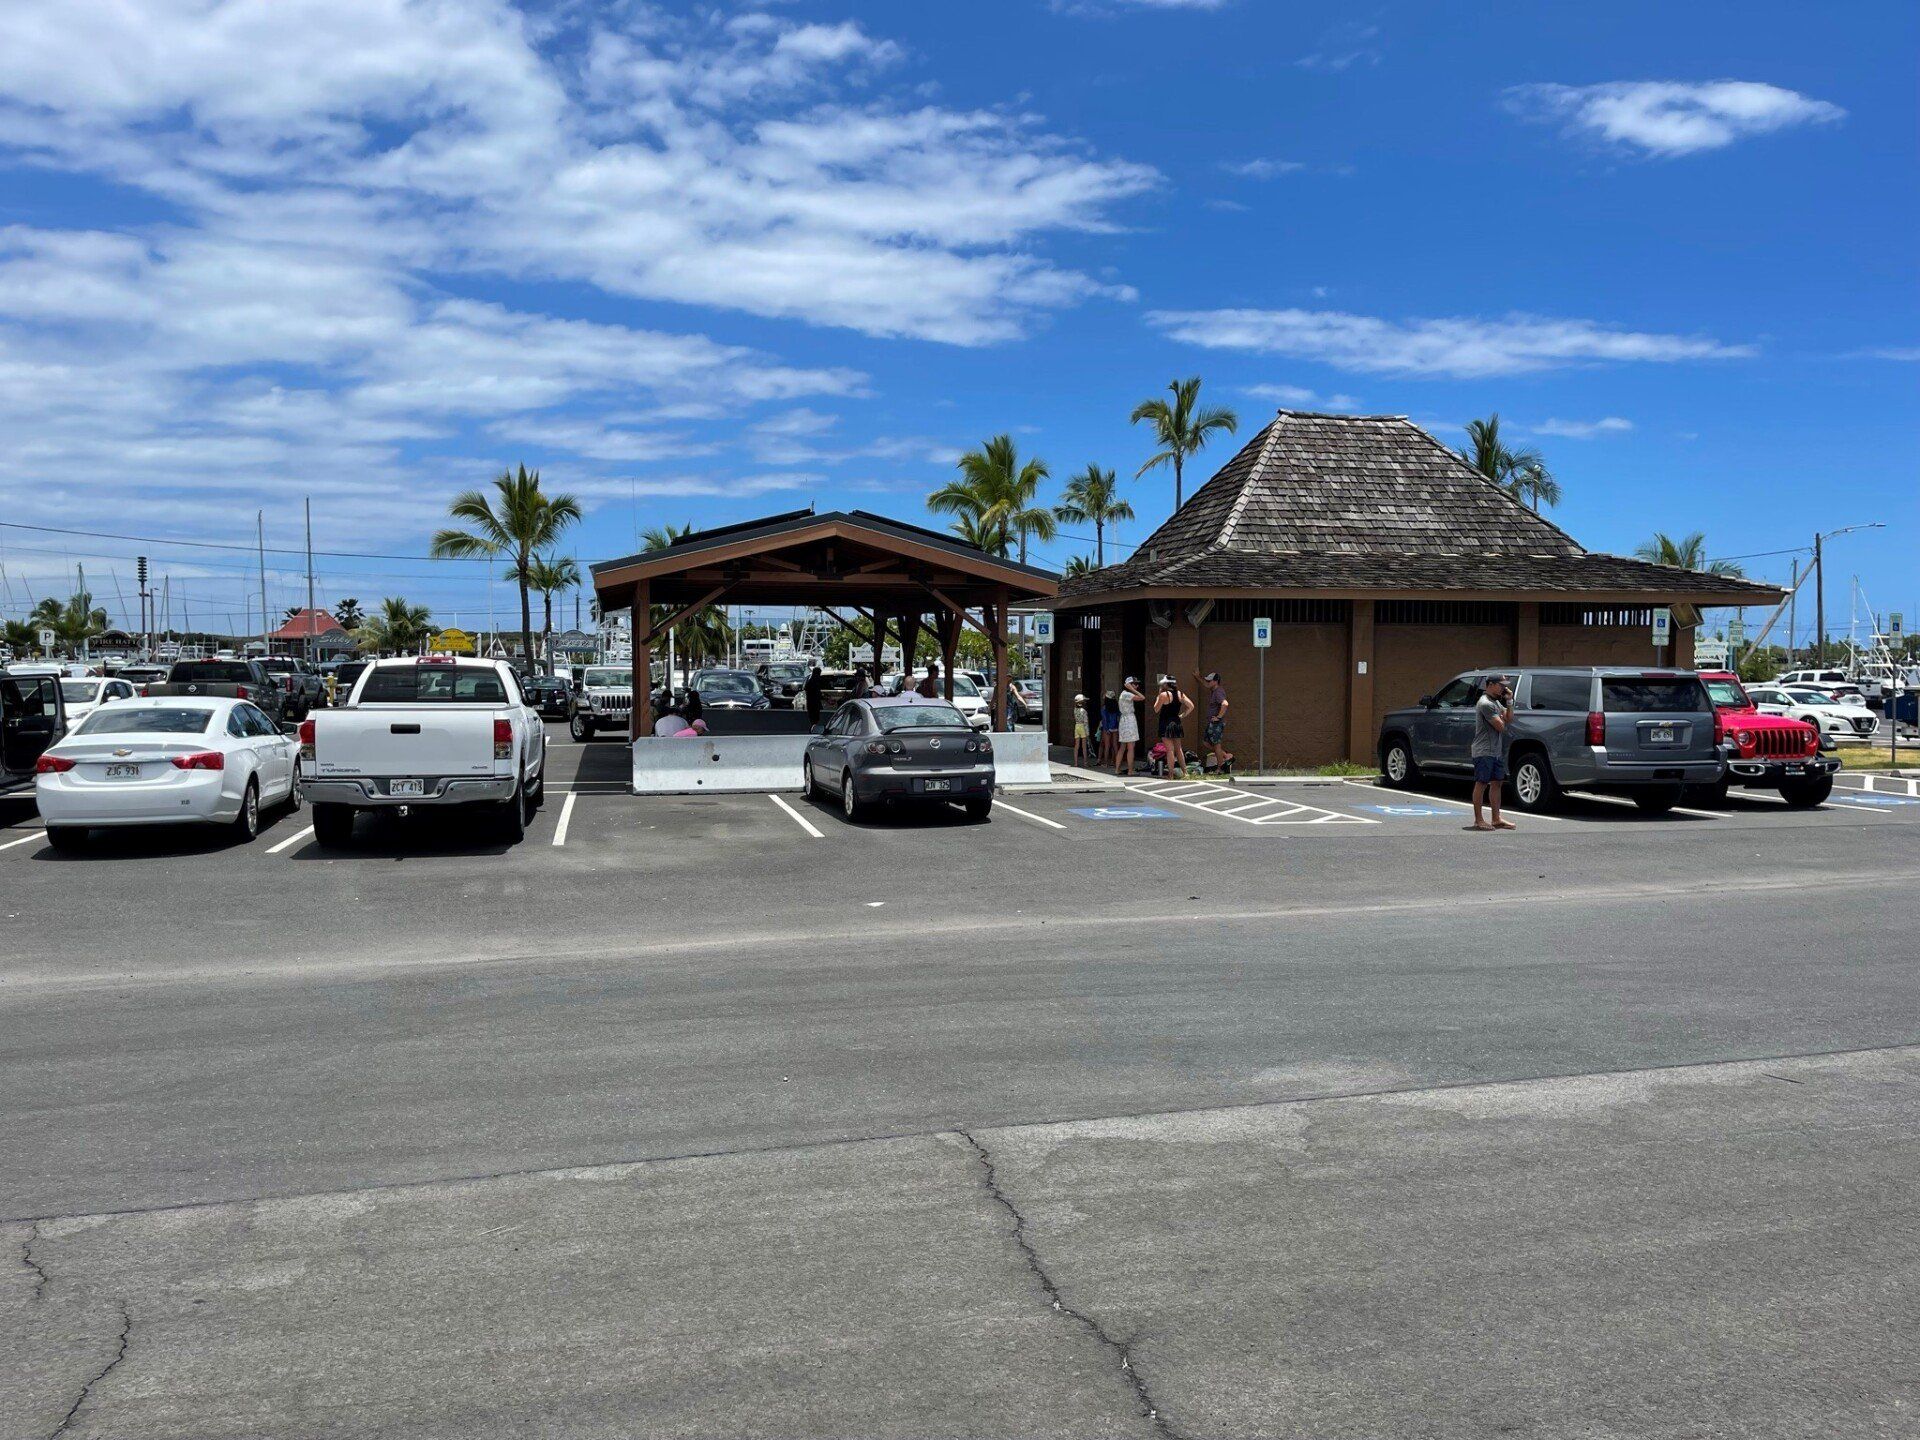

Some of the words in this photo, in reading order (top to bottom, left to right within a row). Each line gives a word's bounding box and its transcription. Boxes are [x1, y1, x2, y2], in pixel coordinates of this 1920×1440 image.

[44, 632, 51, 640] P
[391, 782, 405, 792] ZCY
[408, 782, 423, 792] 413
